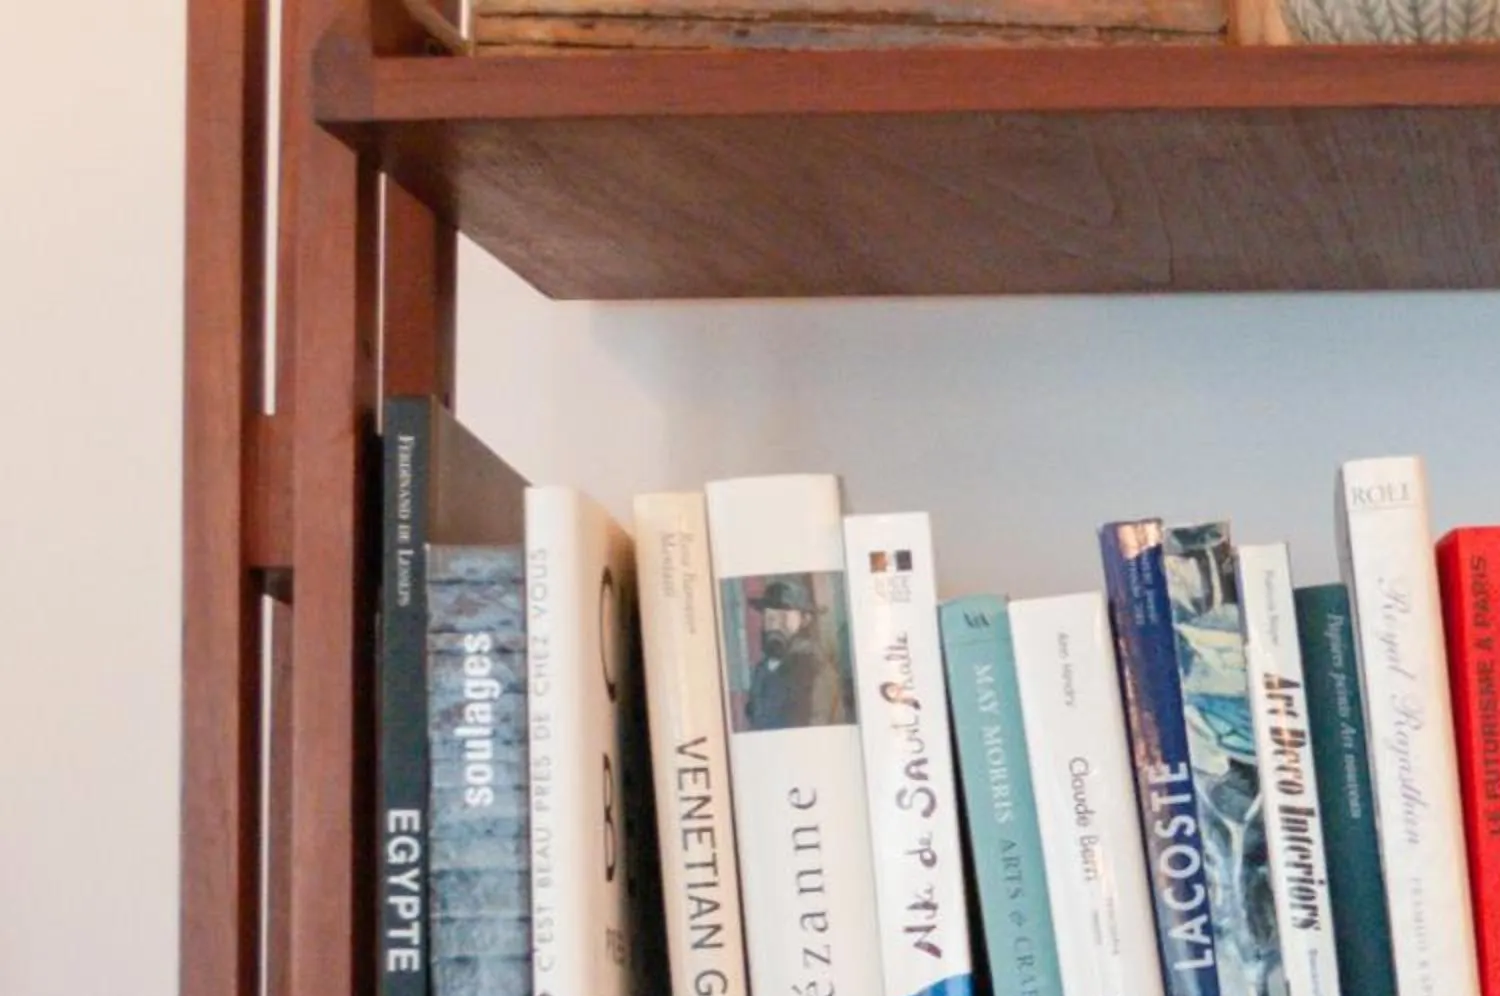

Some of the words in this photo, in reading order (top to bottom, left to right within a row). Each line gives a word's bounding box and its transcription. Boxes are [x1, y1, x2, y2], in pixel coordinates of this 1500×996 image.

[531, 549, 549, 618] VOUS
[1468, 555, 1492, 628] PARIS
[533, 636, 551, 697] CHEZ
[973, 663, 1000, 718] MAY
[1263, 672, 1300, 717] Art
[453, 631, 501, 808] soulages
[534, 713, 551, 741] DE
[1340, 721, 1356, 749] Art
[980, 724, 1014, 824] MORRIS
[1068, 757, 1091, 829] Claude
[1269, 727, 1306, 796] Deco
[535, 828, 553, 888] BEAU
[675, 737, 724, 952] VENETIAN
[907, 833, 939, 872] de
[999, 839, 1024, 901] ARTS
[1149, 761, 1214, 969] LACOSTE
[1278, 805, 1327, 930] Interiors
[386, 808, 421, 974] EGYPTE
[903, 884, 943, 959] Niki
